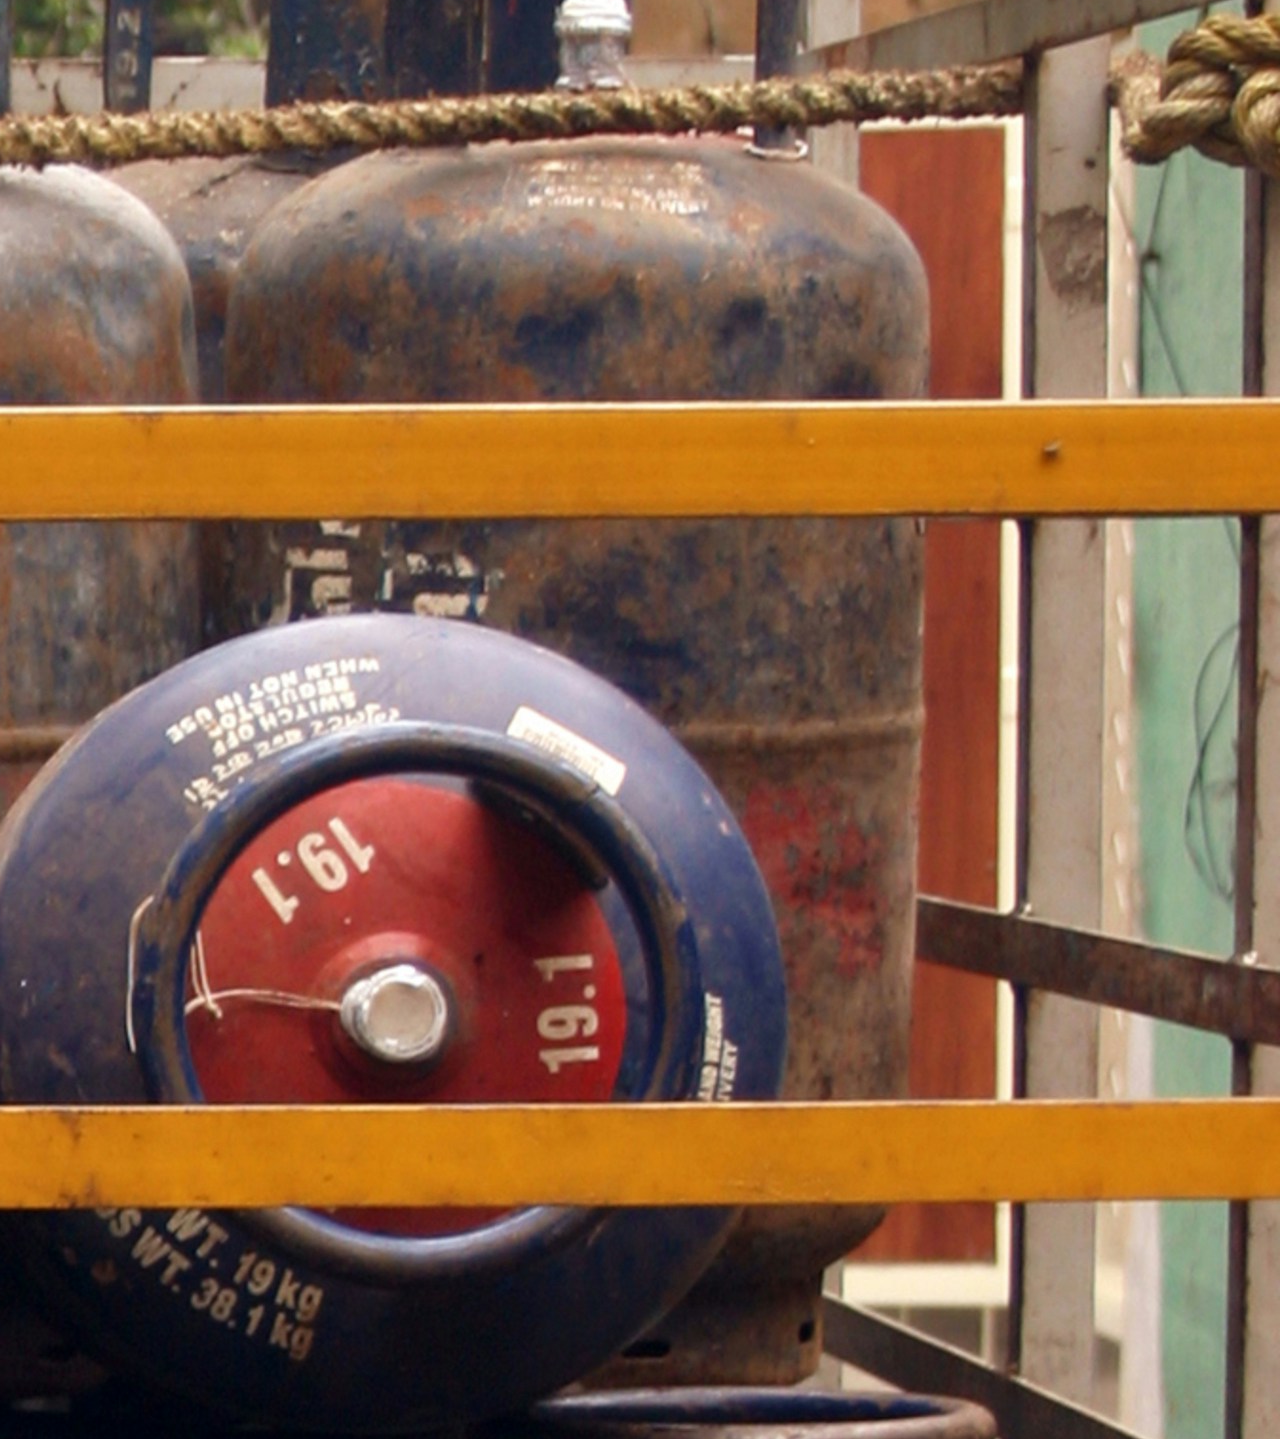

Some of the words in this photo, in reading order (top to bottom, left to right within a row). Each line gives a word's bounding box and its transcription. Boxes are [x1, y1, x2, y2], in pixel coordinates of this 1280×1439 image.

[248, 669, 299, 701] NOT
[303, 657, 381, 682] WHEN
[206, 674, 352, 741] REGULATOR
[213, 690, 244, 712] IN
[258, 689, 357, 733] SWITCH
[165, 705, 215, 747] USE
[212, 722, 256, 759] OFF
[251, 816, 377, 926] 19.1
[533, 954, 601, 1074] 19.1
[165, 1208, 230, 1268] WT.
[233, 1250, 277, 1296] 19
[274, 1266, 324, 1322] kg
[130, 1224, 191, 1294] WT.
[190, 1276, 265, 1336] 38.1
[268, 1312, 315, 1360] kg
